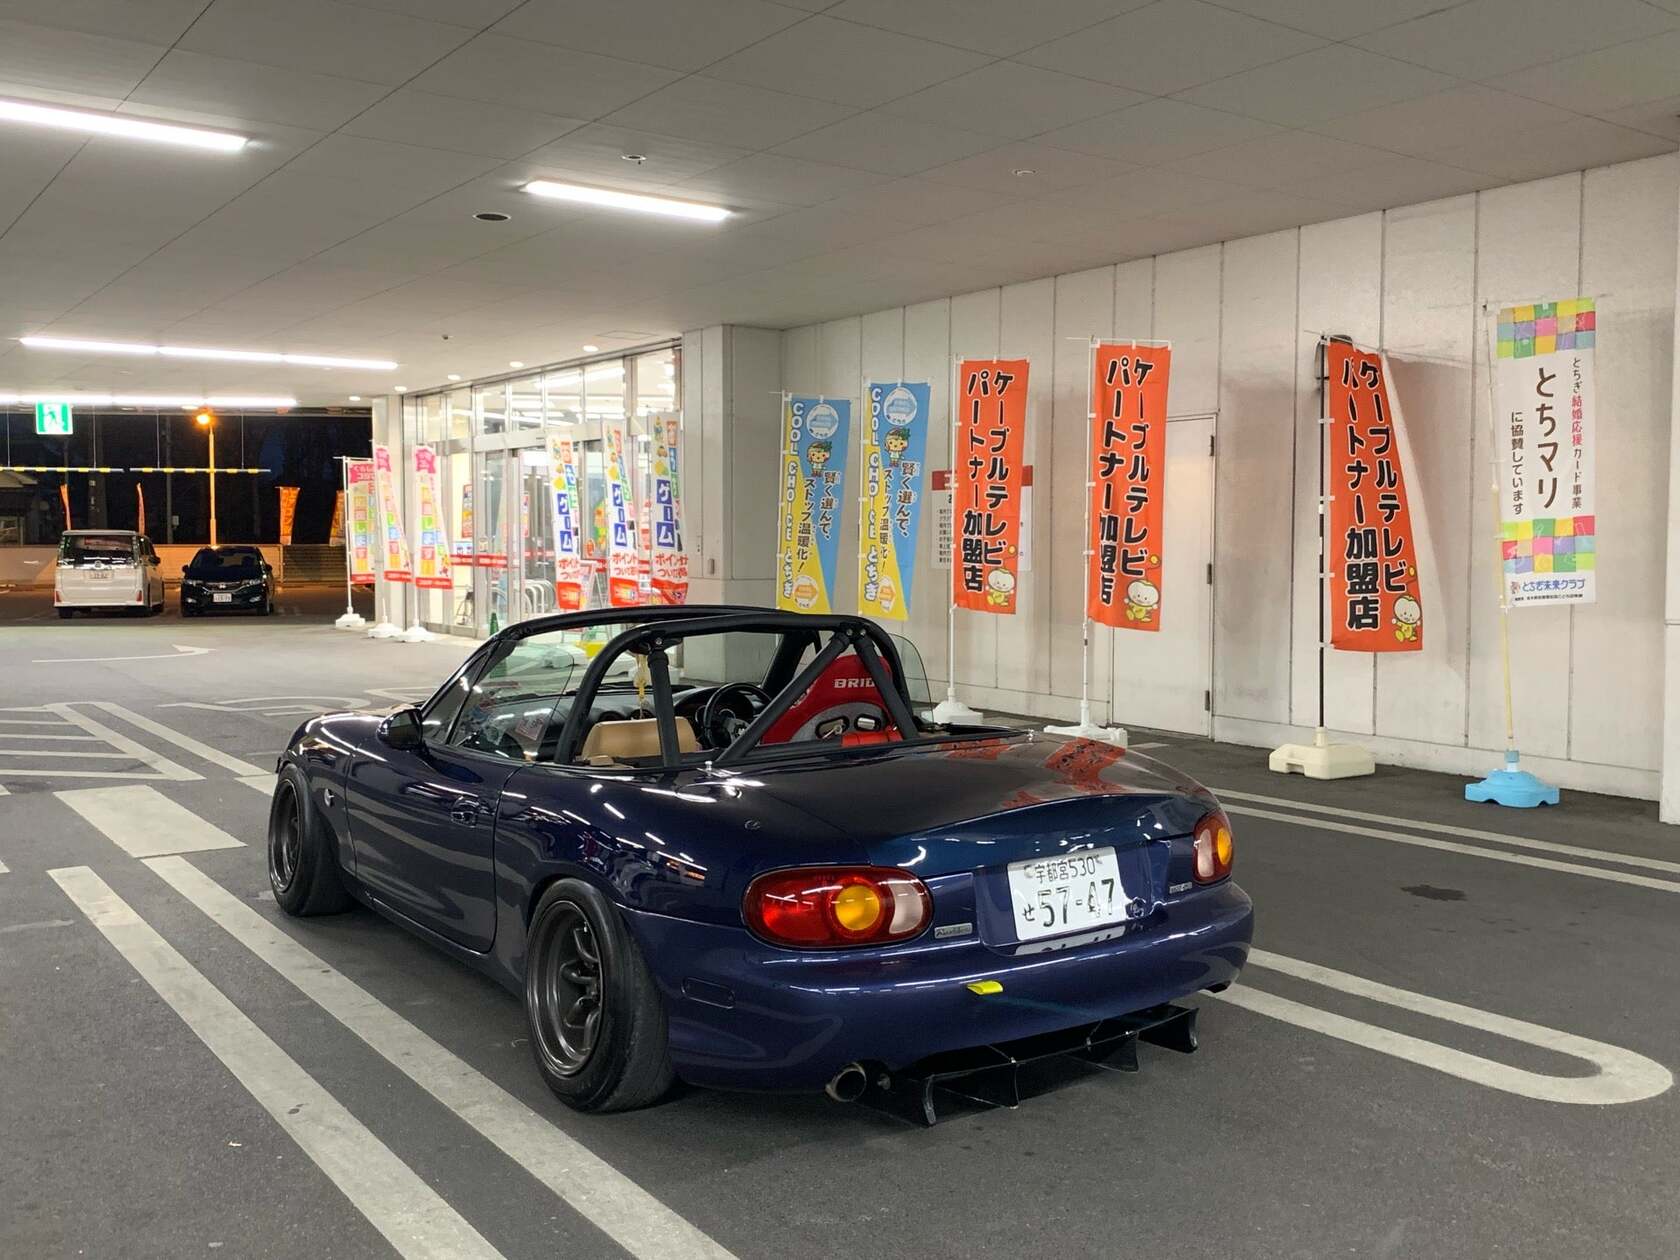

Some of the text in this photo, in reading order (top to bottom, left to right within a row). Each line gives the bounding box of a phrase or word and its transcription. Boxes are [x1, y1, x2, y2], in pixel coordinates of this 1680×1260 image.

[612, 483, 627, 547] ゲーム
[656, 479, 675, 547] ゲーム
[783, 402, 805, 599] COOL CHOICE とちぎ
[864, 387, 883, 602] COOL CHOICE とちぎ
[962, 370, 990, 592] パートナー加盟店
[983, 371, 1014, 566] ケーブルテレビ
[1099, 357, 1127, 605] パートナー加盟店
[1121, 358, 1154, 577] ケーブルテレビ
[1341, 356, 1380, 631] パートナー加盟店
[1359, 359, 1408, 594] ケーブルテレビ
[1511, 411, 1524, 515] に協賛しています
[1535, 367, 1559, 509] とちマリ
[834, 678, 875, 688] BRID
